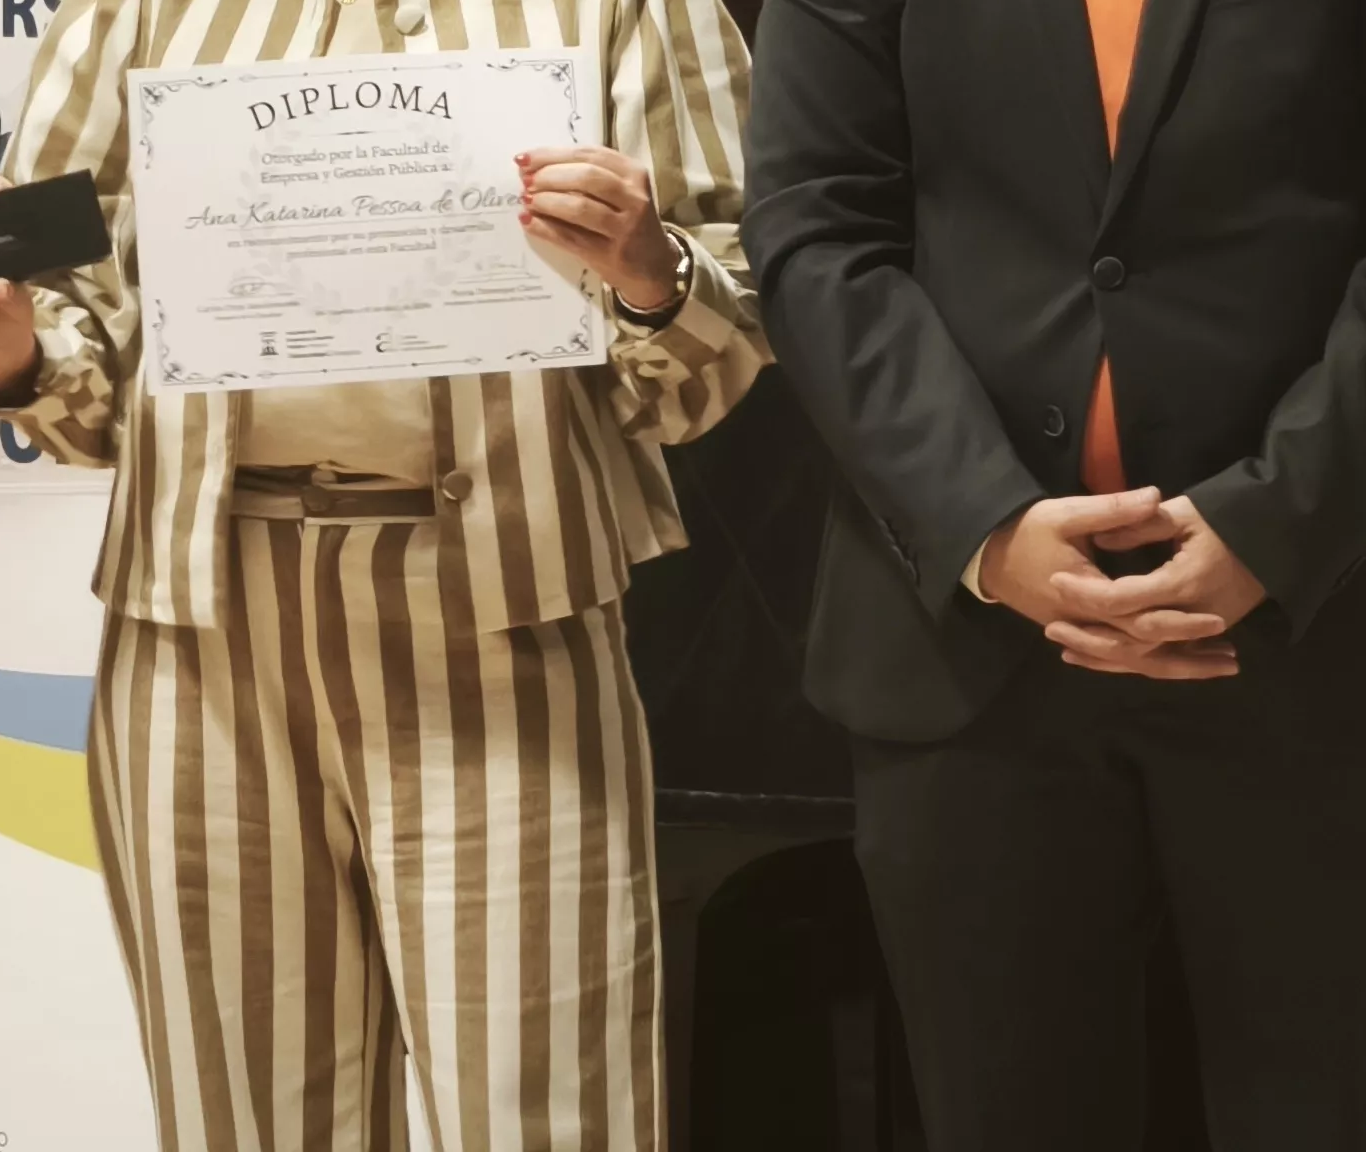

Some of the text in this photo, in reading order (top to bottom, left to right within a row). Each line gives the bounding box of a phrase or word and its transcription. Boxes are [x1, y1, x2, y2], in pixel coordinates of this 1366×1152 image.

[246, 81, 453, 131] DIPLOMA
[261, 139, 451, 166] Otorgado por la Facultad de
[260, 171, 320, 186] Empresa
[333, 164, 385, 180] Gestión
[388, 160, 438, 176] Pública
[184, 205, 237, 230] Ana
[241, 201, 345, 228] Katarina
[351, 194, 423, 218] Pessoa
[429, 188, 454, 214] de
